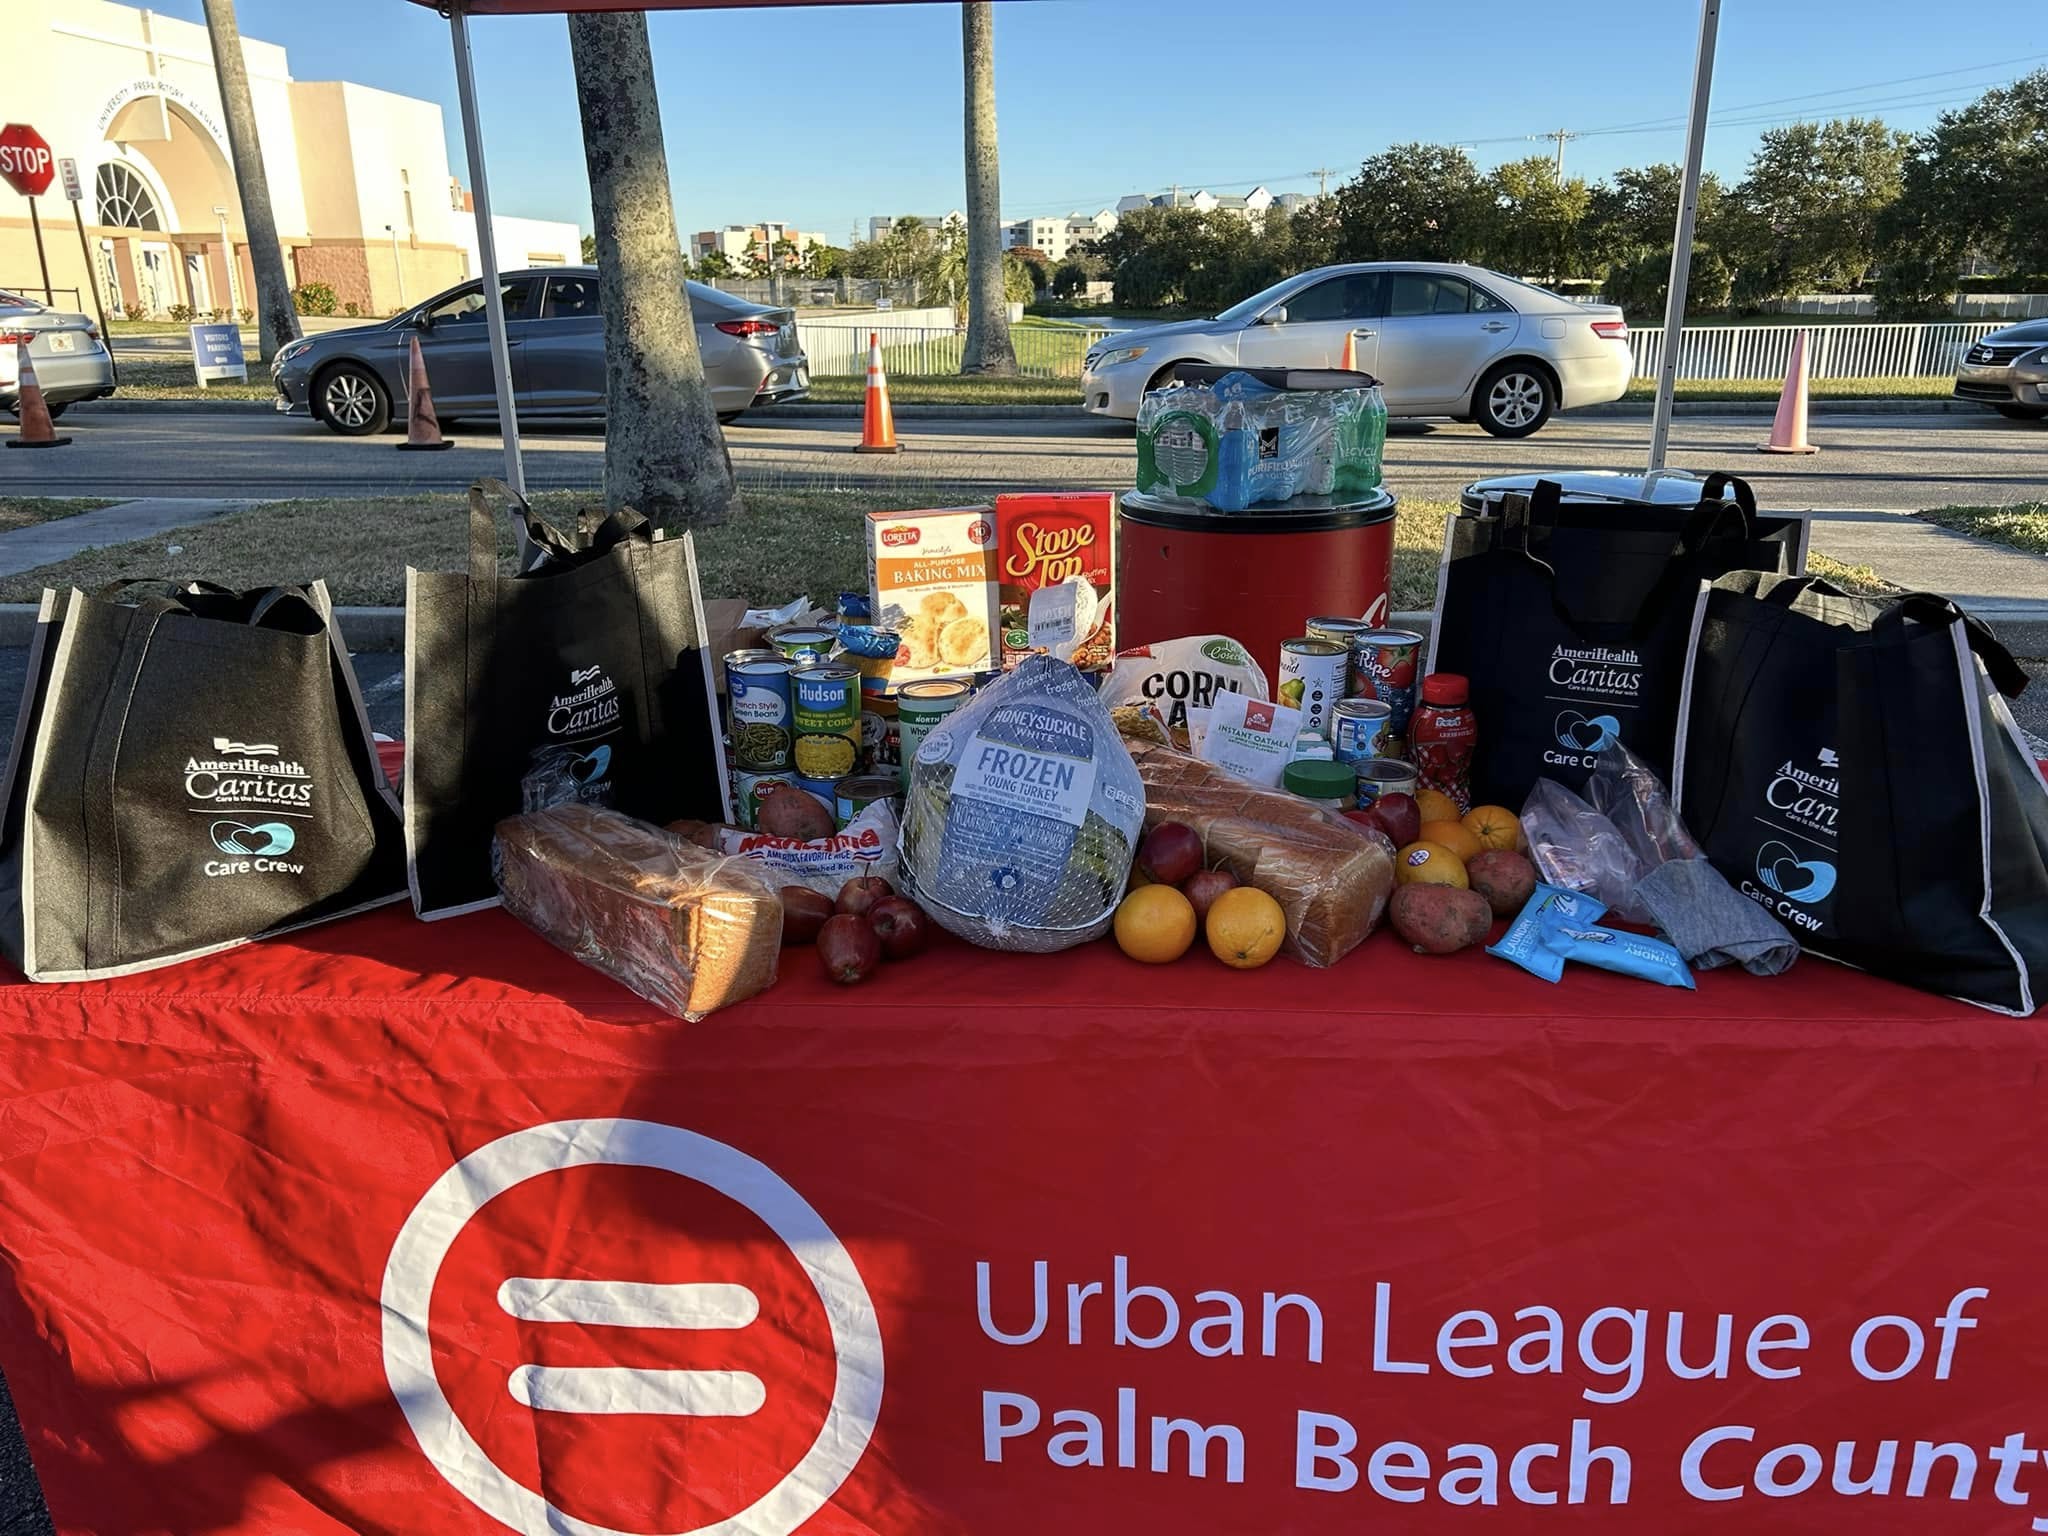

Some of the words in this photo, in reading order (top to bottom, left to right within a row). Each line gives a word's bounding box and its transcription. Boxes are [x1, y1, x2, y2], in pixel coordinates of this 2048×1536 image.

[0, 145, 50, 174] STOP
[883, 531, 918, 543] LORETTA
[1005, 522, 1096, 577] Stove
[893, 567, 953, 584] BAKING
[957, 564, 986, 578] MIX
[913, 557, 966, 569] ALL-PURPOSE
[1036, 552, 1083, 589] Top
[1359, 649, 1392, 678] Ripe
[1551, 643, 1639, 663] AmeriHealth
[1548, 657, 1642, 690] Caritas
[550, 676, 614, 708] AmeriHealth
[799, 682, 845, 702] Hudson
[548, 696, 619, 734] Caritas
[754, 710, 779, 718] Beans
[759, 701, 778, 711] Style
[911, 726, 930, 736] Whol
[993, 709, 1088, 741] HONEYSUCKLE
[1016, 727, 1056, 743] WHITE
[1218, 724, 1252, 740] INSTANT
[185, 756, 305, 775] AmeriHealth
[977, 747, 1075, 791] FROZEN
[1543, 750, 1579, 767] Care
[186, 771, 314, 801] Caritas
[983, 773, 1018, 793] YOUNG
[1019, 782, 1059, 802] TURKEY
[1766, 776, 1839, 826] Cari
[1785, 811, 1802, 822] Care
[204, 860, 250, 877] Care
[254, 858, 304, 875] Crew
[800, 849, 832, 863] FAVORITE
[838, 862, 855, 871] Rice
[1740, 880, 1774, 909] Care
[1777, 901, 1824, 932] Crew
[1503, 918, 1533, 956] LAUNDRY
[976, 1256, 1323, 1364] Urban
[1374, 1281, 1810, 1404] League
[1850, 1287, 1990, 1381] of
[982, 1387, 1245, 1483] Palm
[1295, 1409, 1632, 1506] Beach
